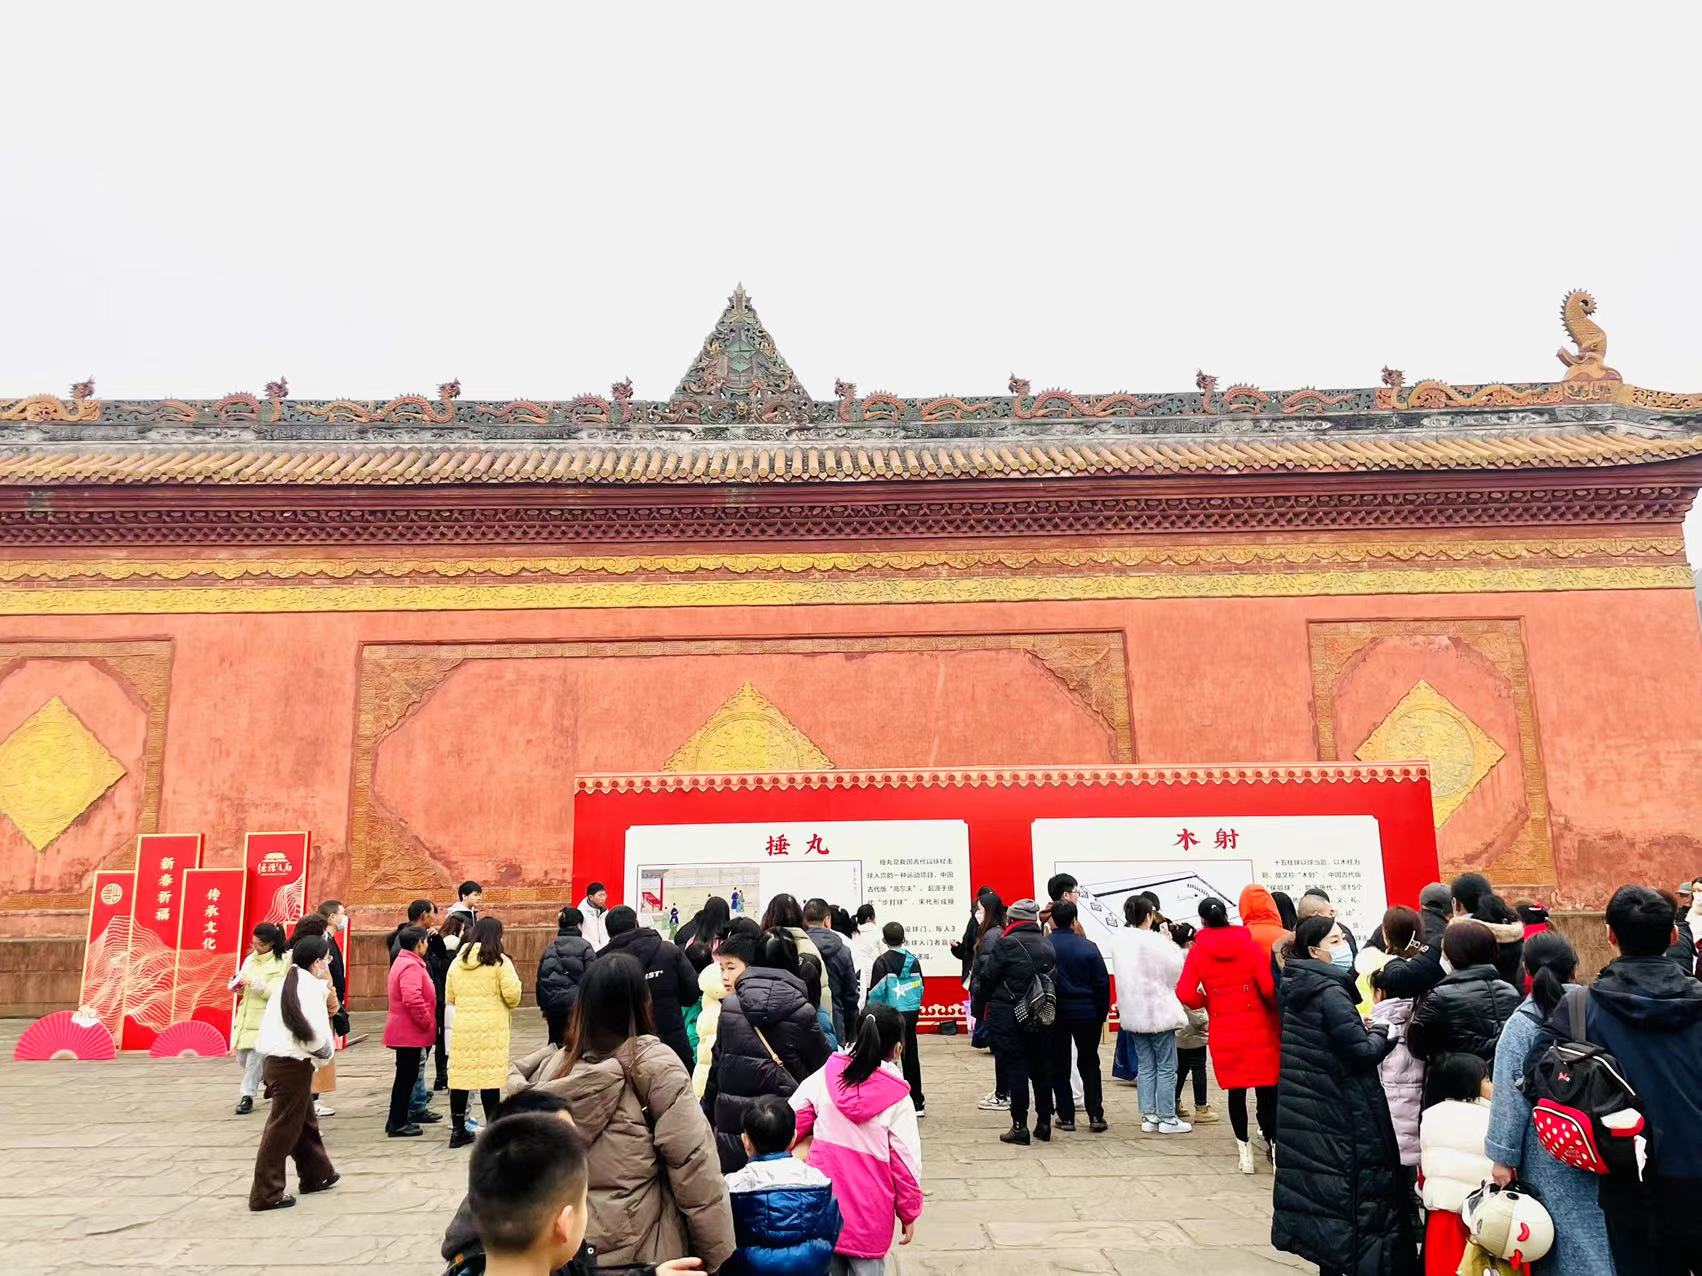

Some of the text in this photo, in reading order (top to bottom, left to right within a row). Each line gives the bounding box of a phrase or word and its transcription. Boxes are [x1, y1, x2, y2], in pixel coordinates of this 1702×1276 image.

[765, 833, 830, 856] 捶丸
[1172, 828, 1240, 851] 木射
[155, 856, 175, 921] 新春祈福
[201, 887, 221, 950] 传承文化
